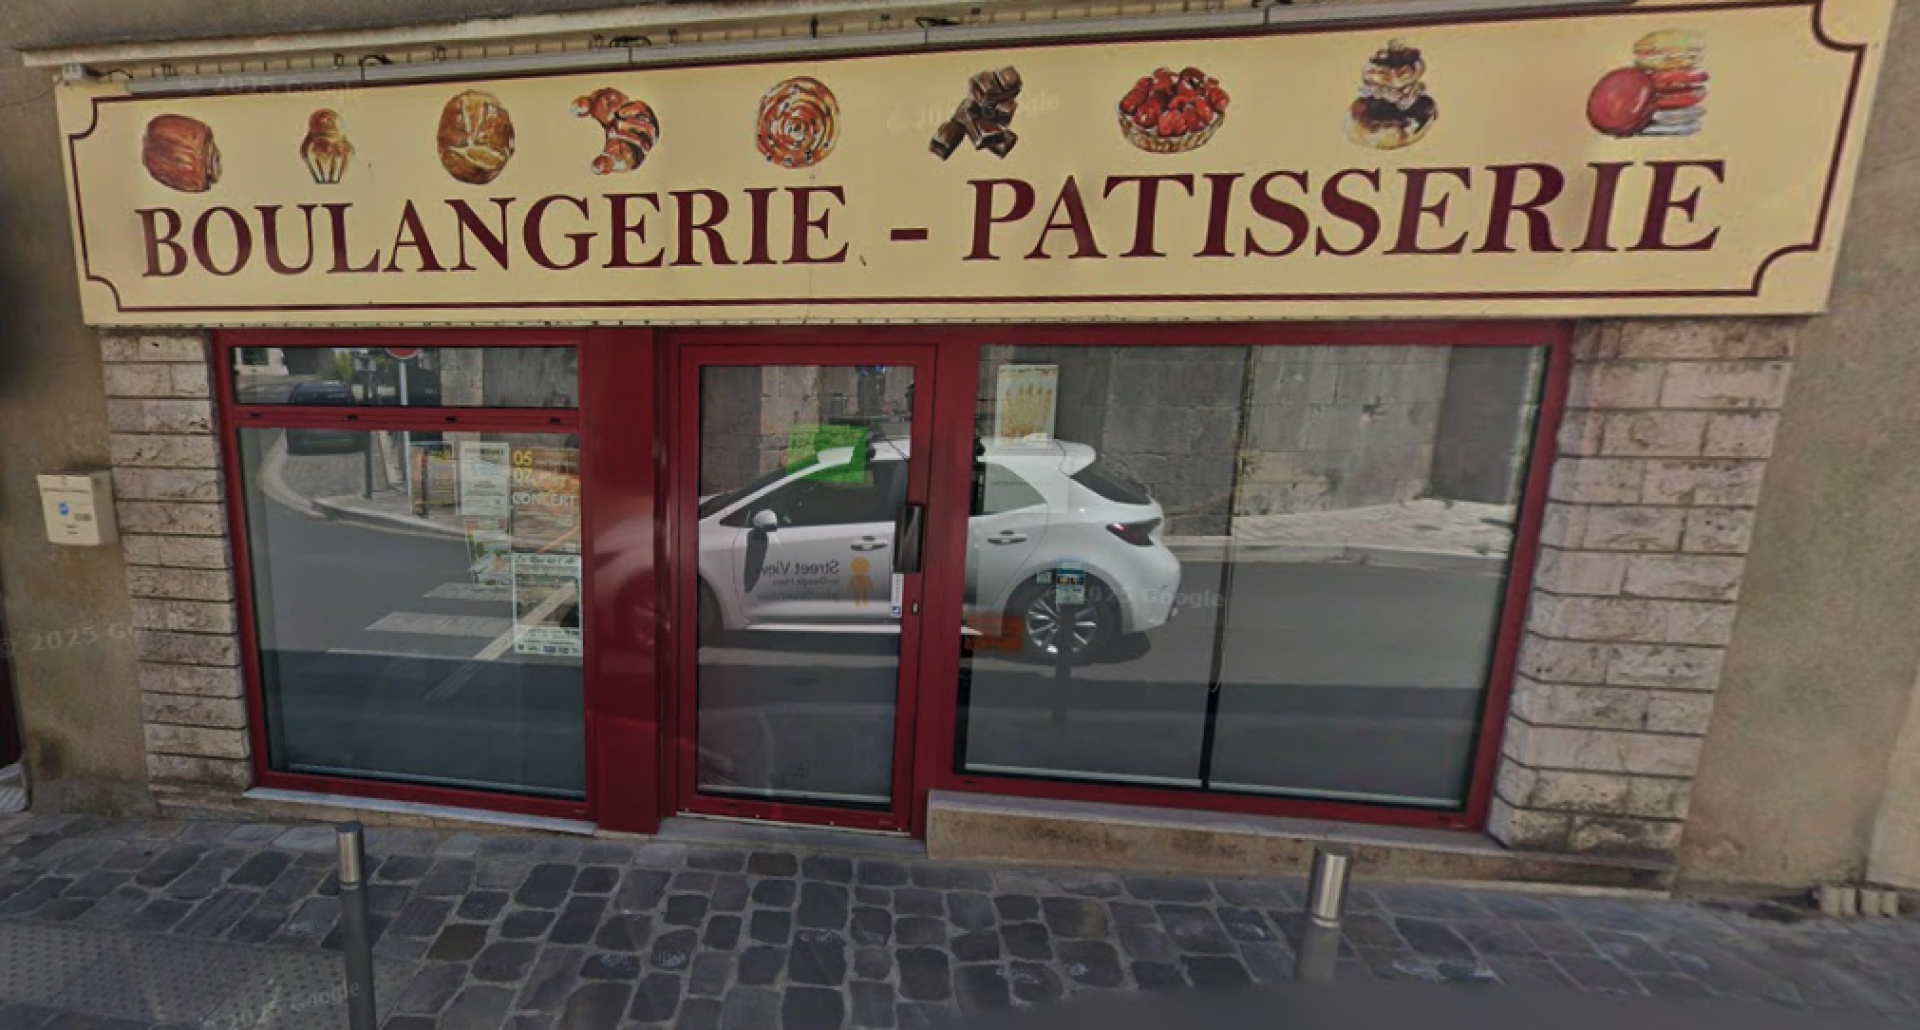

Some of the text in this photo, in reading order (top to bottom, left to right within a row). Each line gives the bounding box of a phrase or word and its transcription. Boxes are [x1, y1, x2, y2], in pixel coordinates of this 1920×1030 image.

[134, 186, 850, 277] BOULANGERIE
[962, 159, 1725, 261] PATISSERIE
[513, 450, 533, 467] 05
